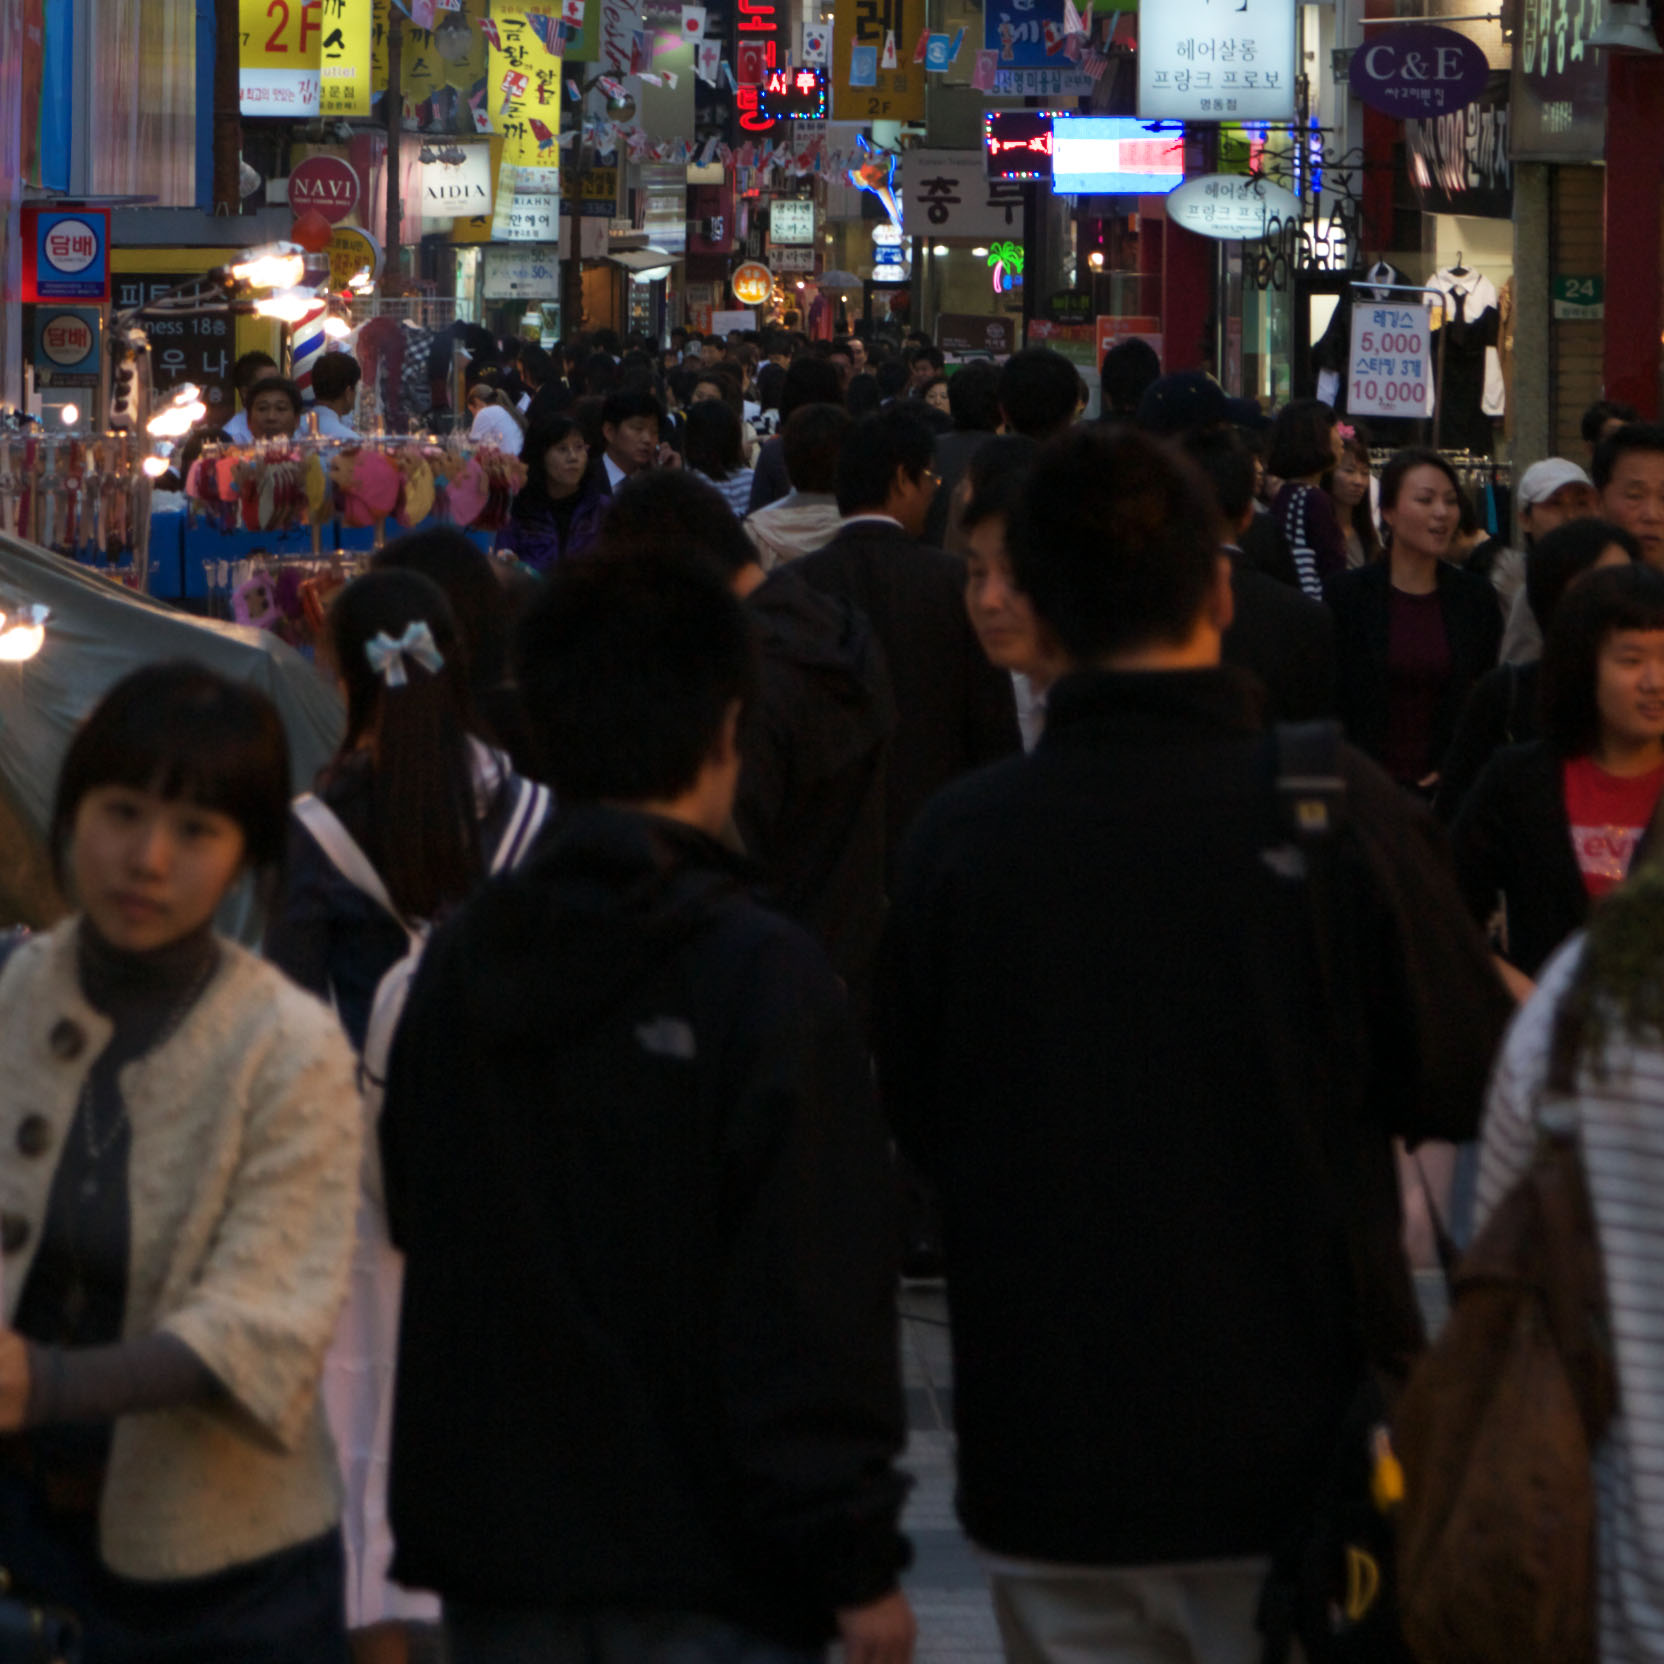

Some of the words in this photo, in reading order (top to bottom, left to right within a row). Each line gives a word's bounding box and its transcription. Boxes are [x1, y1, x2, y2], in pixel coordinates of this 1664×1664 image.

[1175, 37, 1259, 64] 헤어살롱
[1364, 44, 1465, 82] C&E
[1151, 68, 1215, 94] 프랑크
[1220, 68, 1284, 93] 프로보
[868, 97, 892, 116] 2F
[1199, 98, 1238, 113] 명동점
[294, 177, 351, 197] NAVI
[50, 234, 93, 257] 담배
[1564, 278, 1595, 298] 24
[47, 327, 87, 348] 담배
[1360, 331, 1422, 356] 5,000
[1355, 357, 1396, 377] 스타킹
[1352, 379, 1426, 404] 10,000
